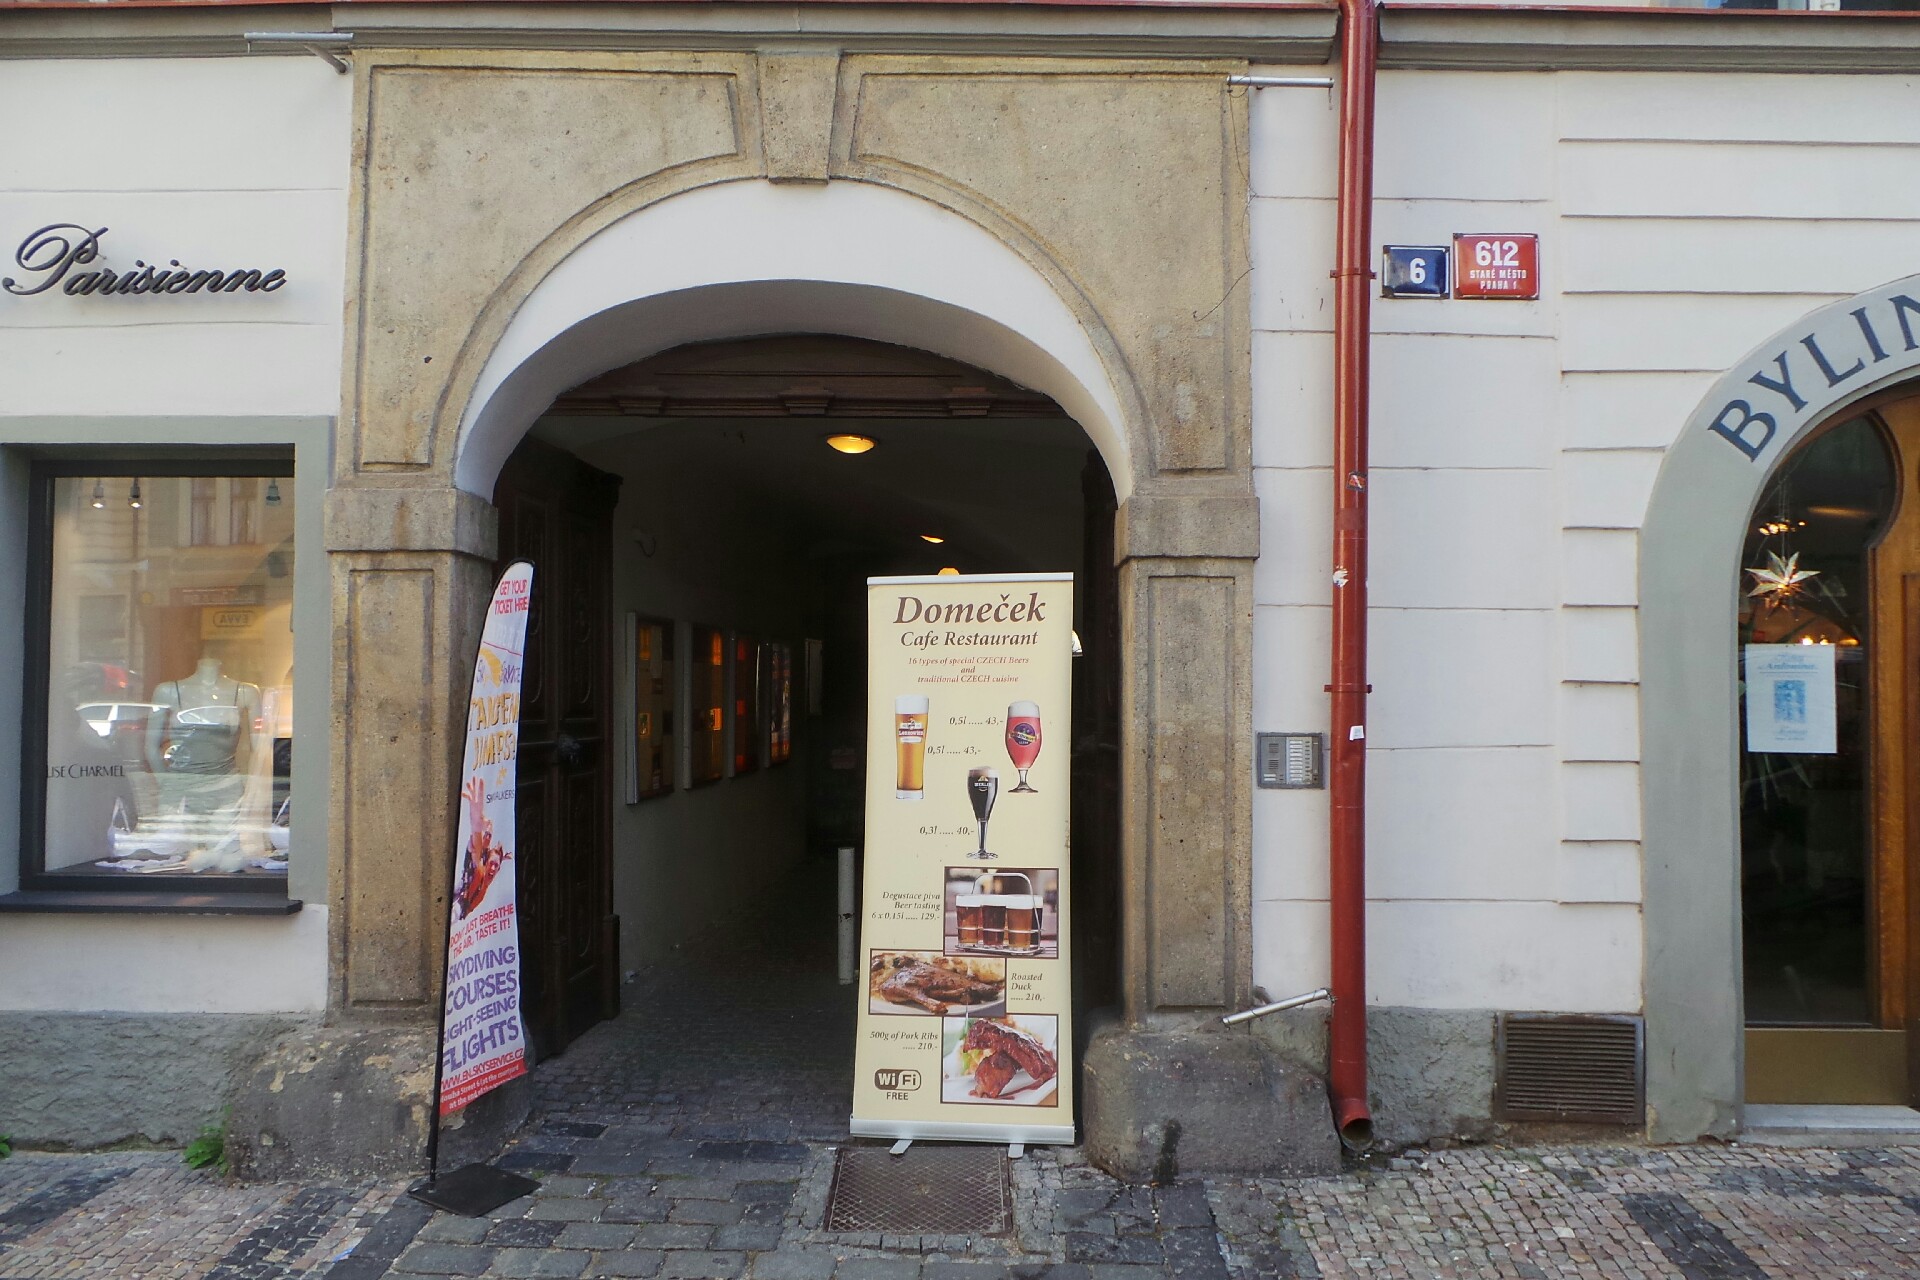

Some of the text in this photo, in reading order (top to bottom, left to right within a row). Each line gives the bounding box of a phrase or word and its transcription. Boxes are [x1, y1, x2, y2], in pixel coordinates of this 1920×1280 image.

[1475, 240, 1519, 266] 612
[2, 223, 287, 295] Parisienne
[1409, 257, 1426, 284] 6
[1470, 267, 1496, 279] STARÉ
[1480, 280, 1509, 290] PRAHA
[893, 592, 1047, 624] Domeček
[900, 630, 1038, 650] Cafe Restaurant
[908, 656, 1029, 667] 16 types of special CZECH Beers
[960, 666, 976, 674] and
[917, 675, 1019, 684] traditional CZECH cuisine
[68, 763, 125, 779] CHARMEL
[882, 891, 941, 902] Degustace piva
[894, 901, 941, 911] Beer tasting
[480, 903, 514, 926] BREATHE
[871, 911, 877, 919] 6
[475, 922, 498, 941] TASTE
[500, 917, 511, 931] IT!
[448, 945, 516, 985] SKYDIVING
[1011, 972, 1043, 981] Roasted
[1011, 982, 1032, 990] Duck
[446, 969, 518, 1016] COURSES
[869, 1030, 939, 1041] 500g of Pork Ribs
[886, 1091, 909, 1101] FREE
